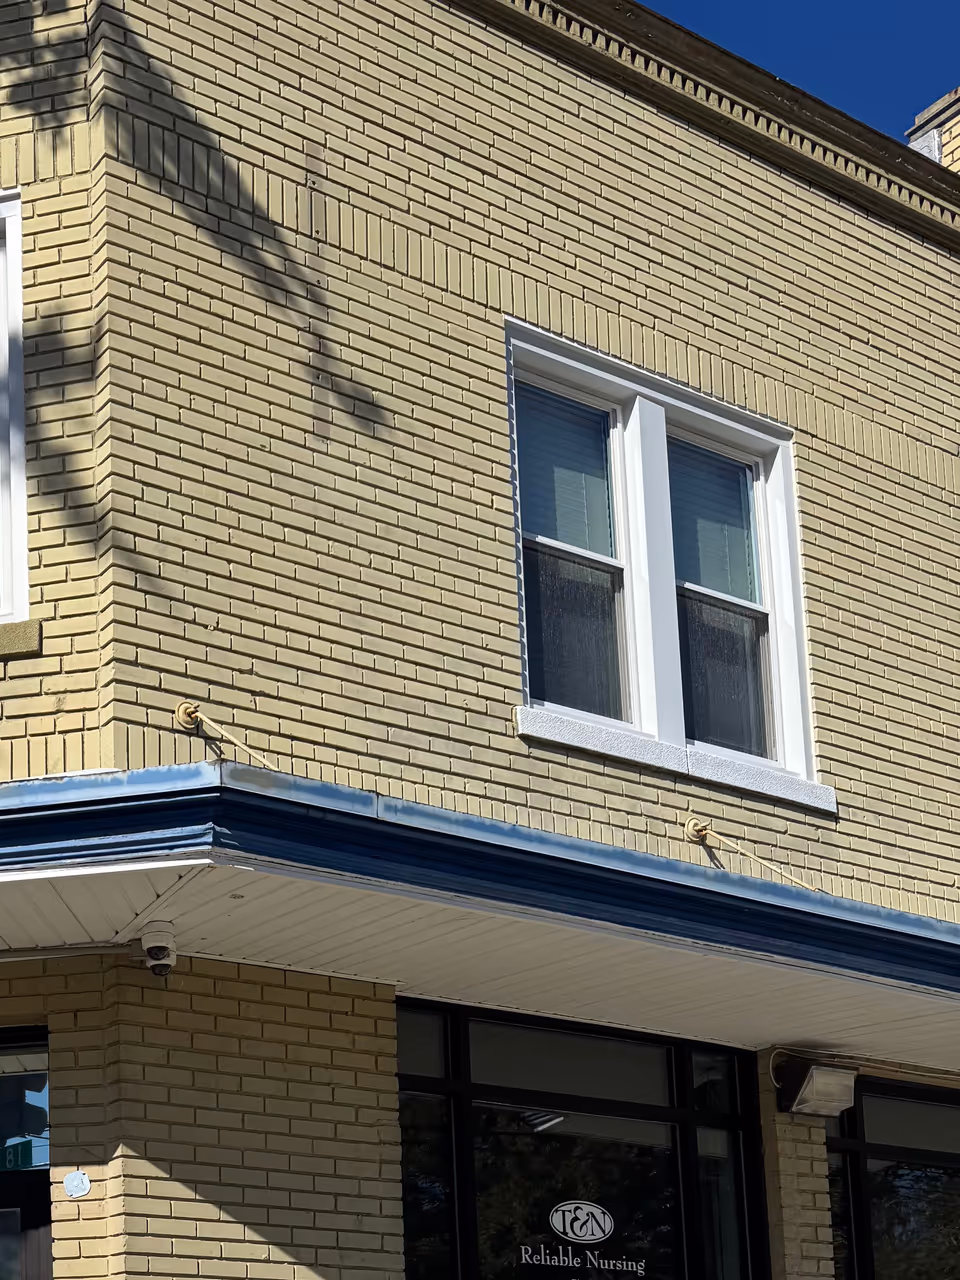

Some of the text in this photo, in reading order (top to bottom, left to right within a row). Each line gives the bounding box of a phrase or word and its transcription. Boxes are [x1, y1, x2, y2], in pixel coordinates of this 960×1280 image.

[554, 1205, 608, 1238] T&N
[520, 1244, 646, 1276] Reliable Nursing
